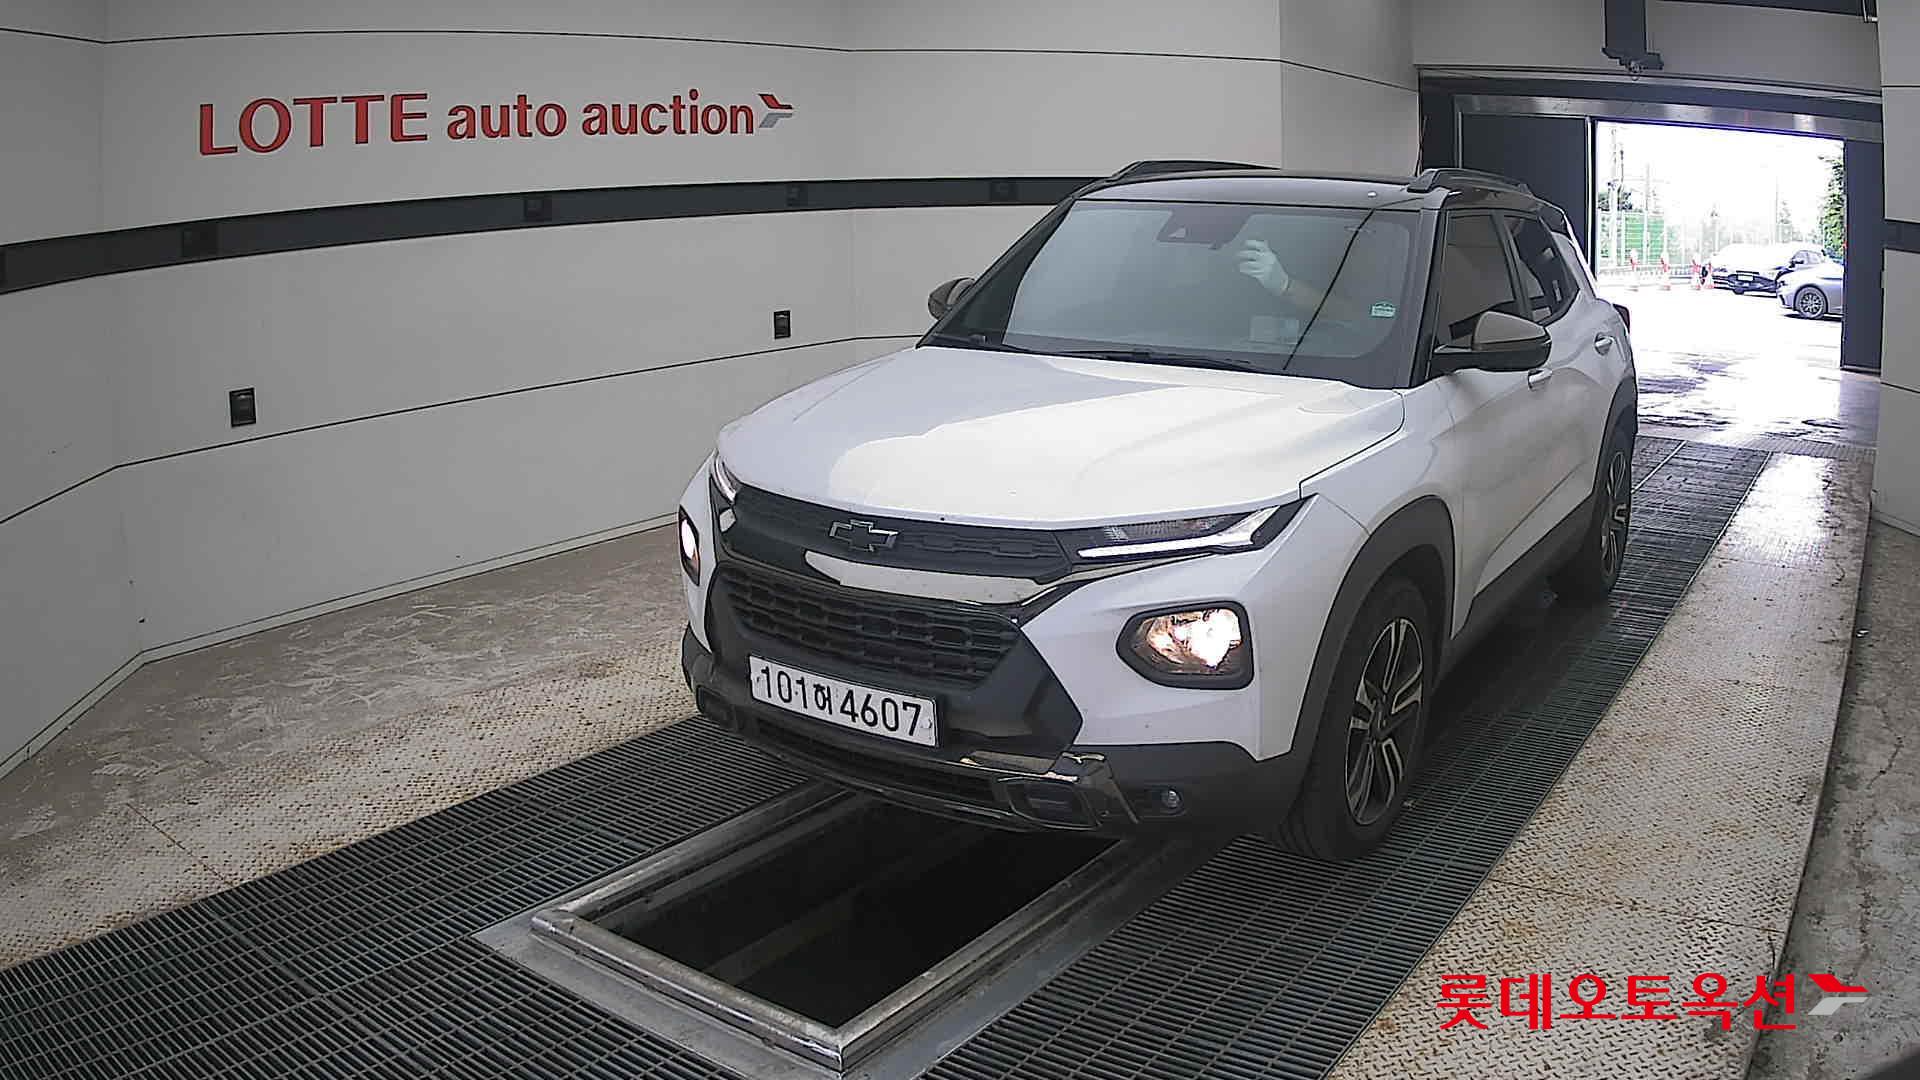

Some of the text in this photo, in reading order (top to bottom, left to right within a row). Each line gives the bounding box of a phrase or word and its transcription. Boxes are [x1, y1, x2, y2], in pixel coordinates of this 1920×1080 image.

[200, 89, 755, 155] LOTTE auto auction
